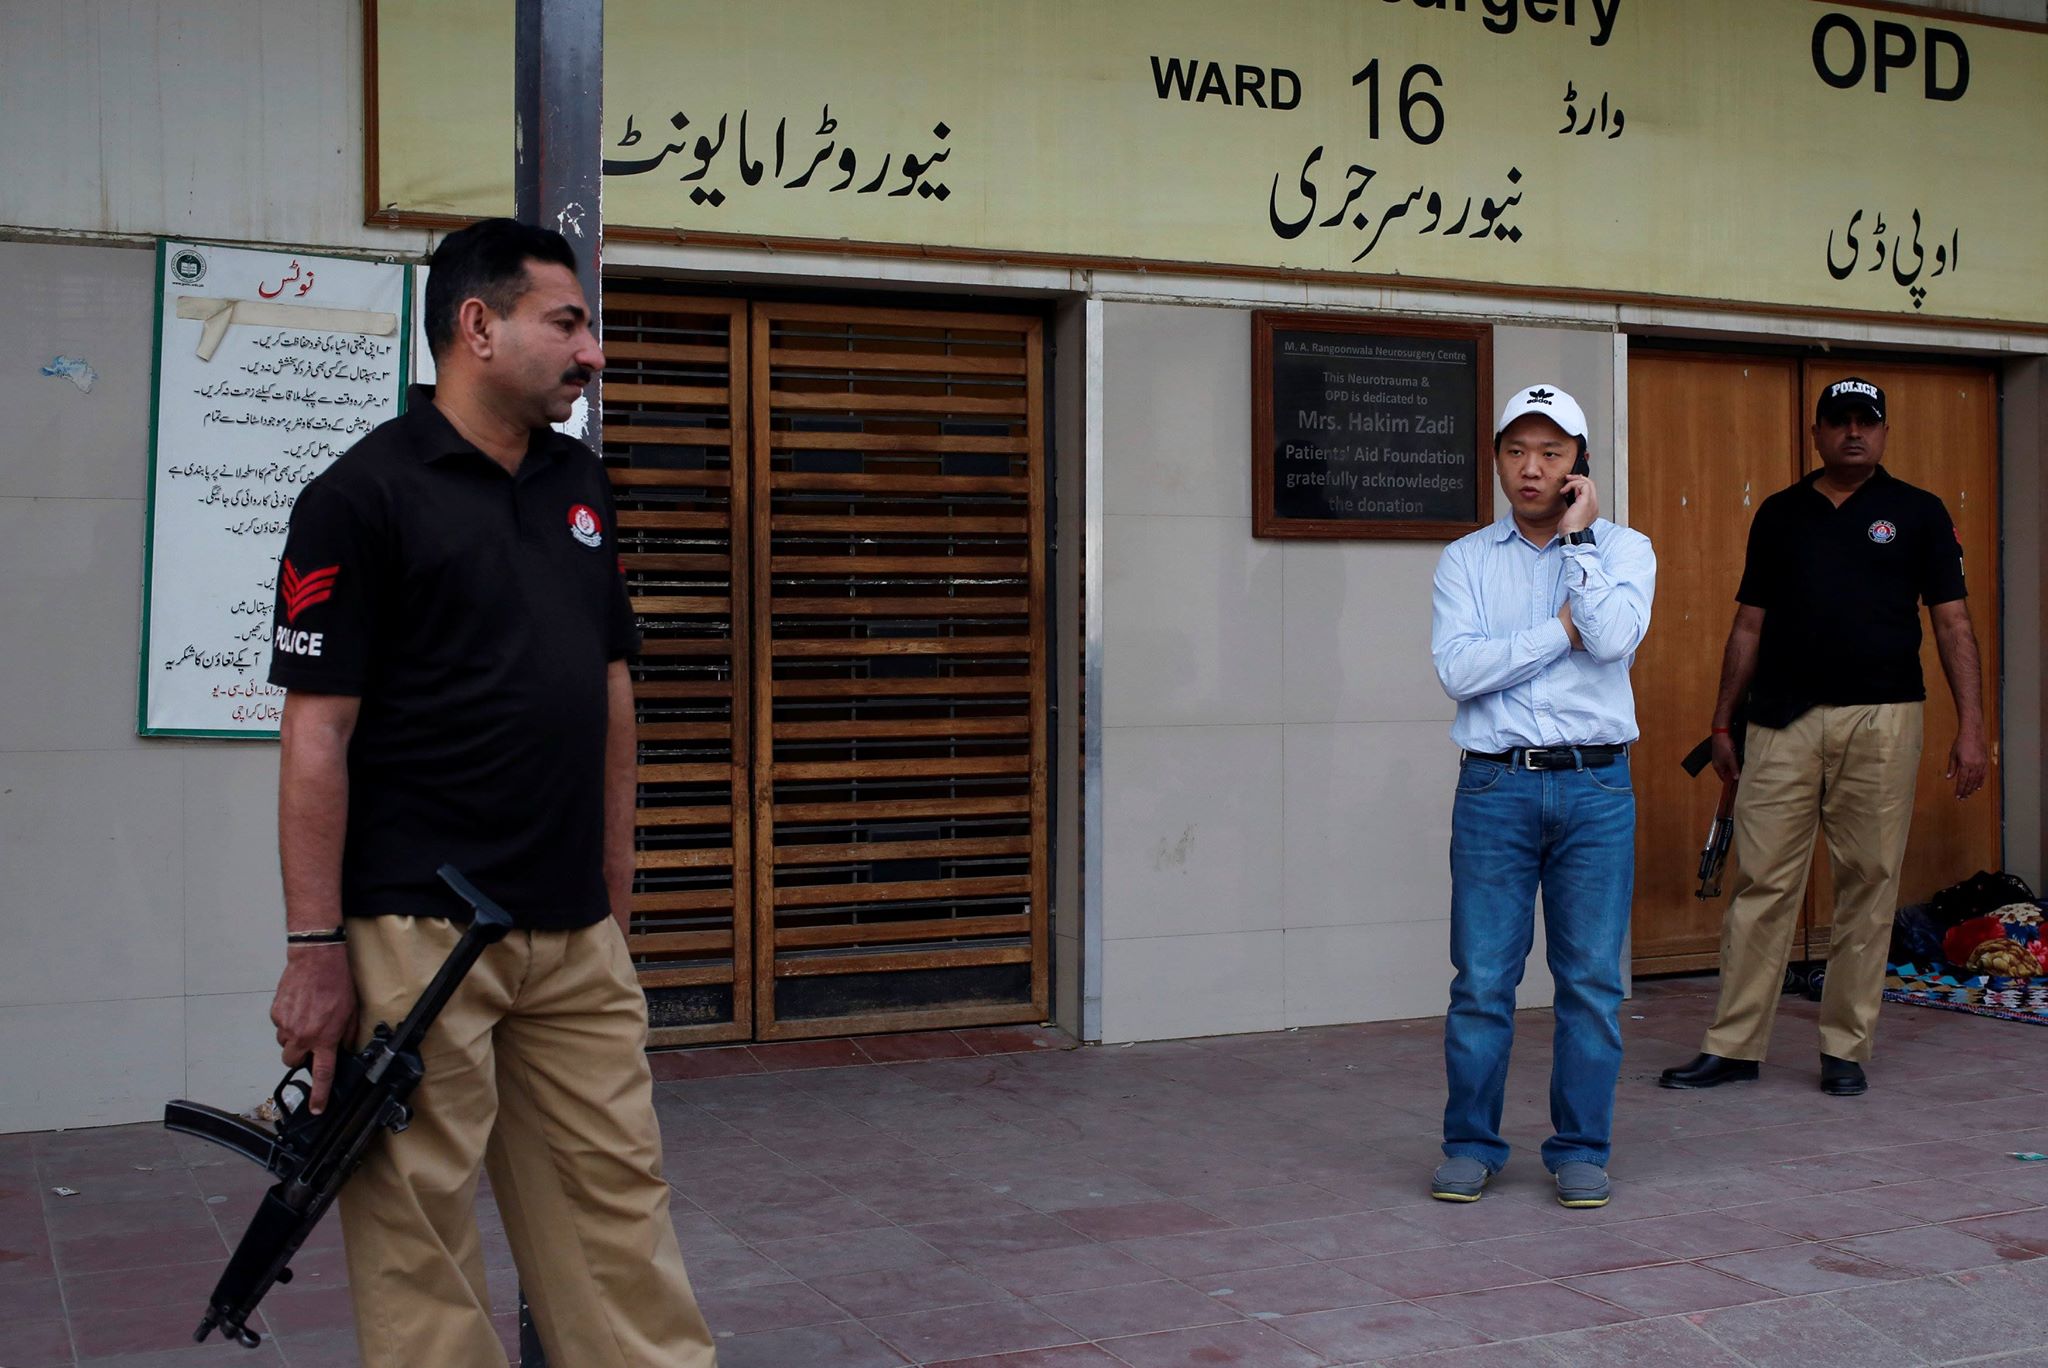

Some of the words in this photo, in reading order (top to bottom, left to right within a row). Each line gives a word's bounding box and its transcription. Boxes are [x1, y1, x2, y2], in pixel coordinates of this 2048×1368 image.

[1811, 12, 1970, 102] OPD
[1150, 56, 1302, 111] WARD
[1352, 58, 1445, 145] 16
[1558, 80, 1625, 140] وارڈ
[258, 259, 314, 299] نوٹس
[1284, 341, 1297, 352] M.
[1312, 343, 1373, 356] Rangoonwala
[1375, 346, 1435, 360] Neurosurgery
[1437, 350, 1467, 361] Centre
[1322, 371, 1345, 384] This
[1347, 373, 1418, 387] Neurotrauma
[1420, 376, 1430, 388] &
[1325, 390, 1349, 402] OPD
[1351, 391, 1360, 402] is
[1363, 392, 1414, 405] dedicated
[1416, 394, 1428, 405] to
[1831, 381, 1878, 400] POLICE
[1299, 410, 1342, 431] Mrs.
[1349, 413, 1409, 433] Hakim
[1415, 415, 1454, 435] Zadi
[1354, 447, 1378, 462] Aid
[1383, 448, 1465, 465] Foundation
[1286, 471, 1358, 489] gratefully
[1362, 473, 1464, 492] acknowledges
[1329, 496, 1353, 511] the
[1358, 497, 1423, 513] donation
[274, 625, 323, 656] POLICE
